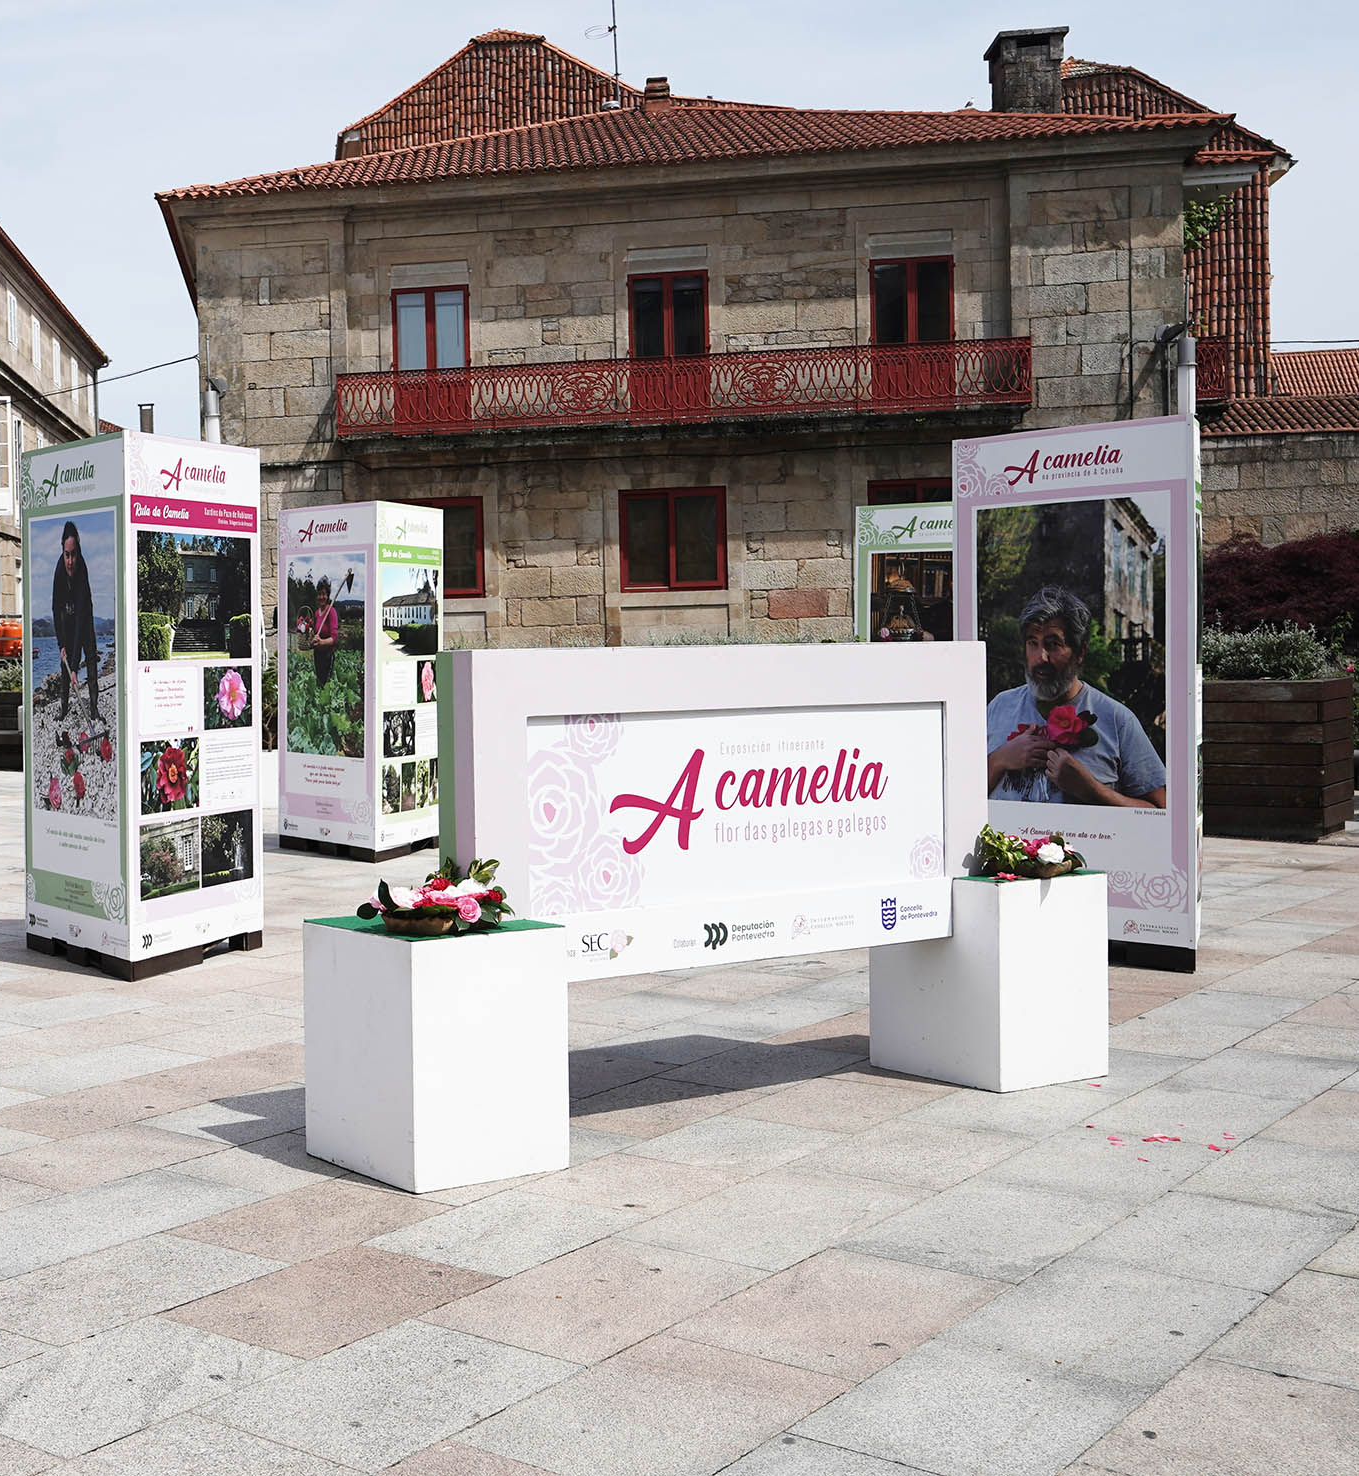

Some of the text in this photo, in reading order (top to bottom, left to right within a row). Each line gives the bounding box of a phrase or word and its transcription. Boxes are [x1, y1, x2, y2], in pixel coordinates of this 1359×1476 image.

[159, 458, 226, 491] A camelia
[1003, 444, 1123, 486] A camelia
[42, 463, 59, 498] A
[60, 460, 94, 484] camelia
[133, 503, 189, 520] Ruta da Camelia
[298, 519, 348, 543] A camelia
[892, 516, 953, 539] A came
[720, 739, 825, 756] Exposición itinerante
[609, 748, 889, 856] A camelia
[714, 814, 887, 844] flor das galegas e galegos
[900, 904, 923, 913] Concello
[908, 910, 938, 919] Pontevedra
[732, 920, 774, 932] Deputación
[732, 929, 775, 942] Pontevedra
[582, 933, 608, 953] SEC
